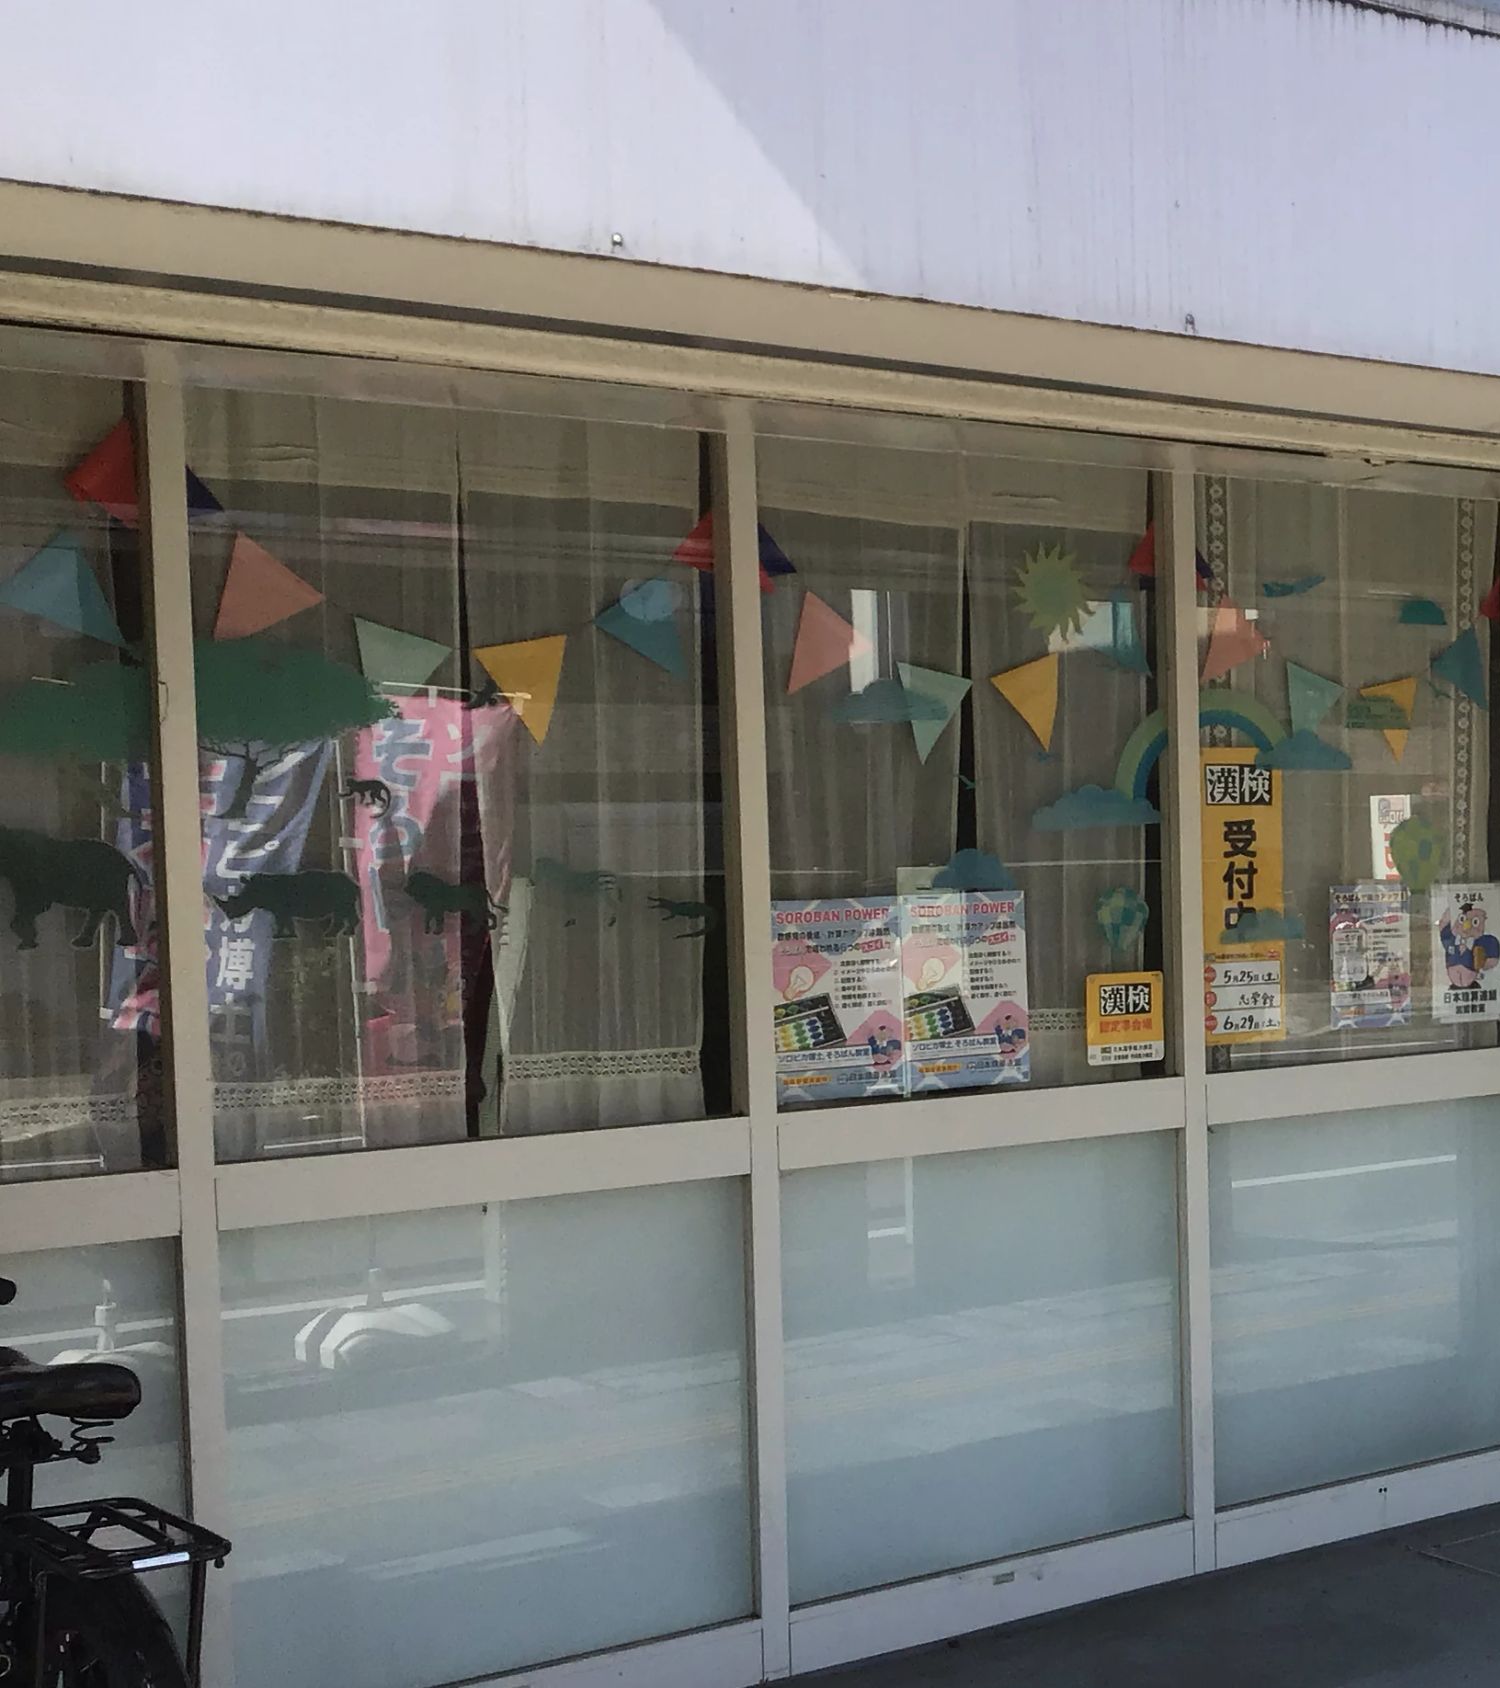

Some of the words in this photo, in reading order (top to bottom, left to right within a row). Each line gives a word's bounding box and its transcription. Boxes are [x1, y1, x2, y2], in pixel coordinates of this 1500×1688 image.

[1206, 764, 1272, 805] 漢検
[1454, 893, 1484, 902] そろばん
[776, 909, 841, 925] SOROBAN
[845, 906, 890, 922] POWER
[910, 903, 968, 918] SOROBAN
[973, 901, 1015, 915] POWER
[1100, 984, 1152, 1015] 漢検
[1444, 989, 1497, 1004] 日本珠算連盟
